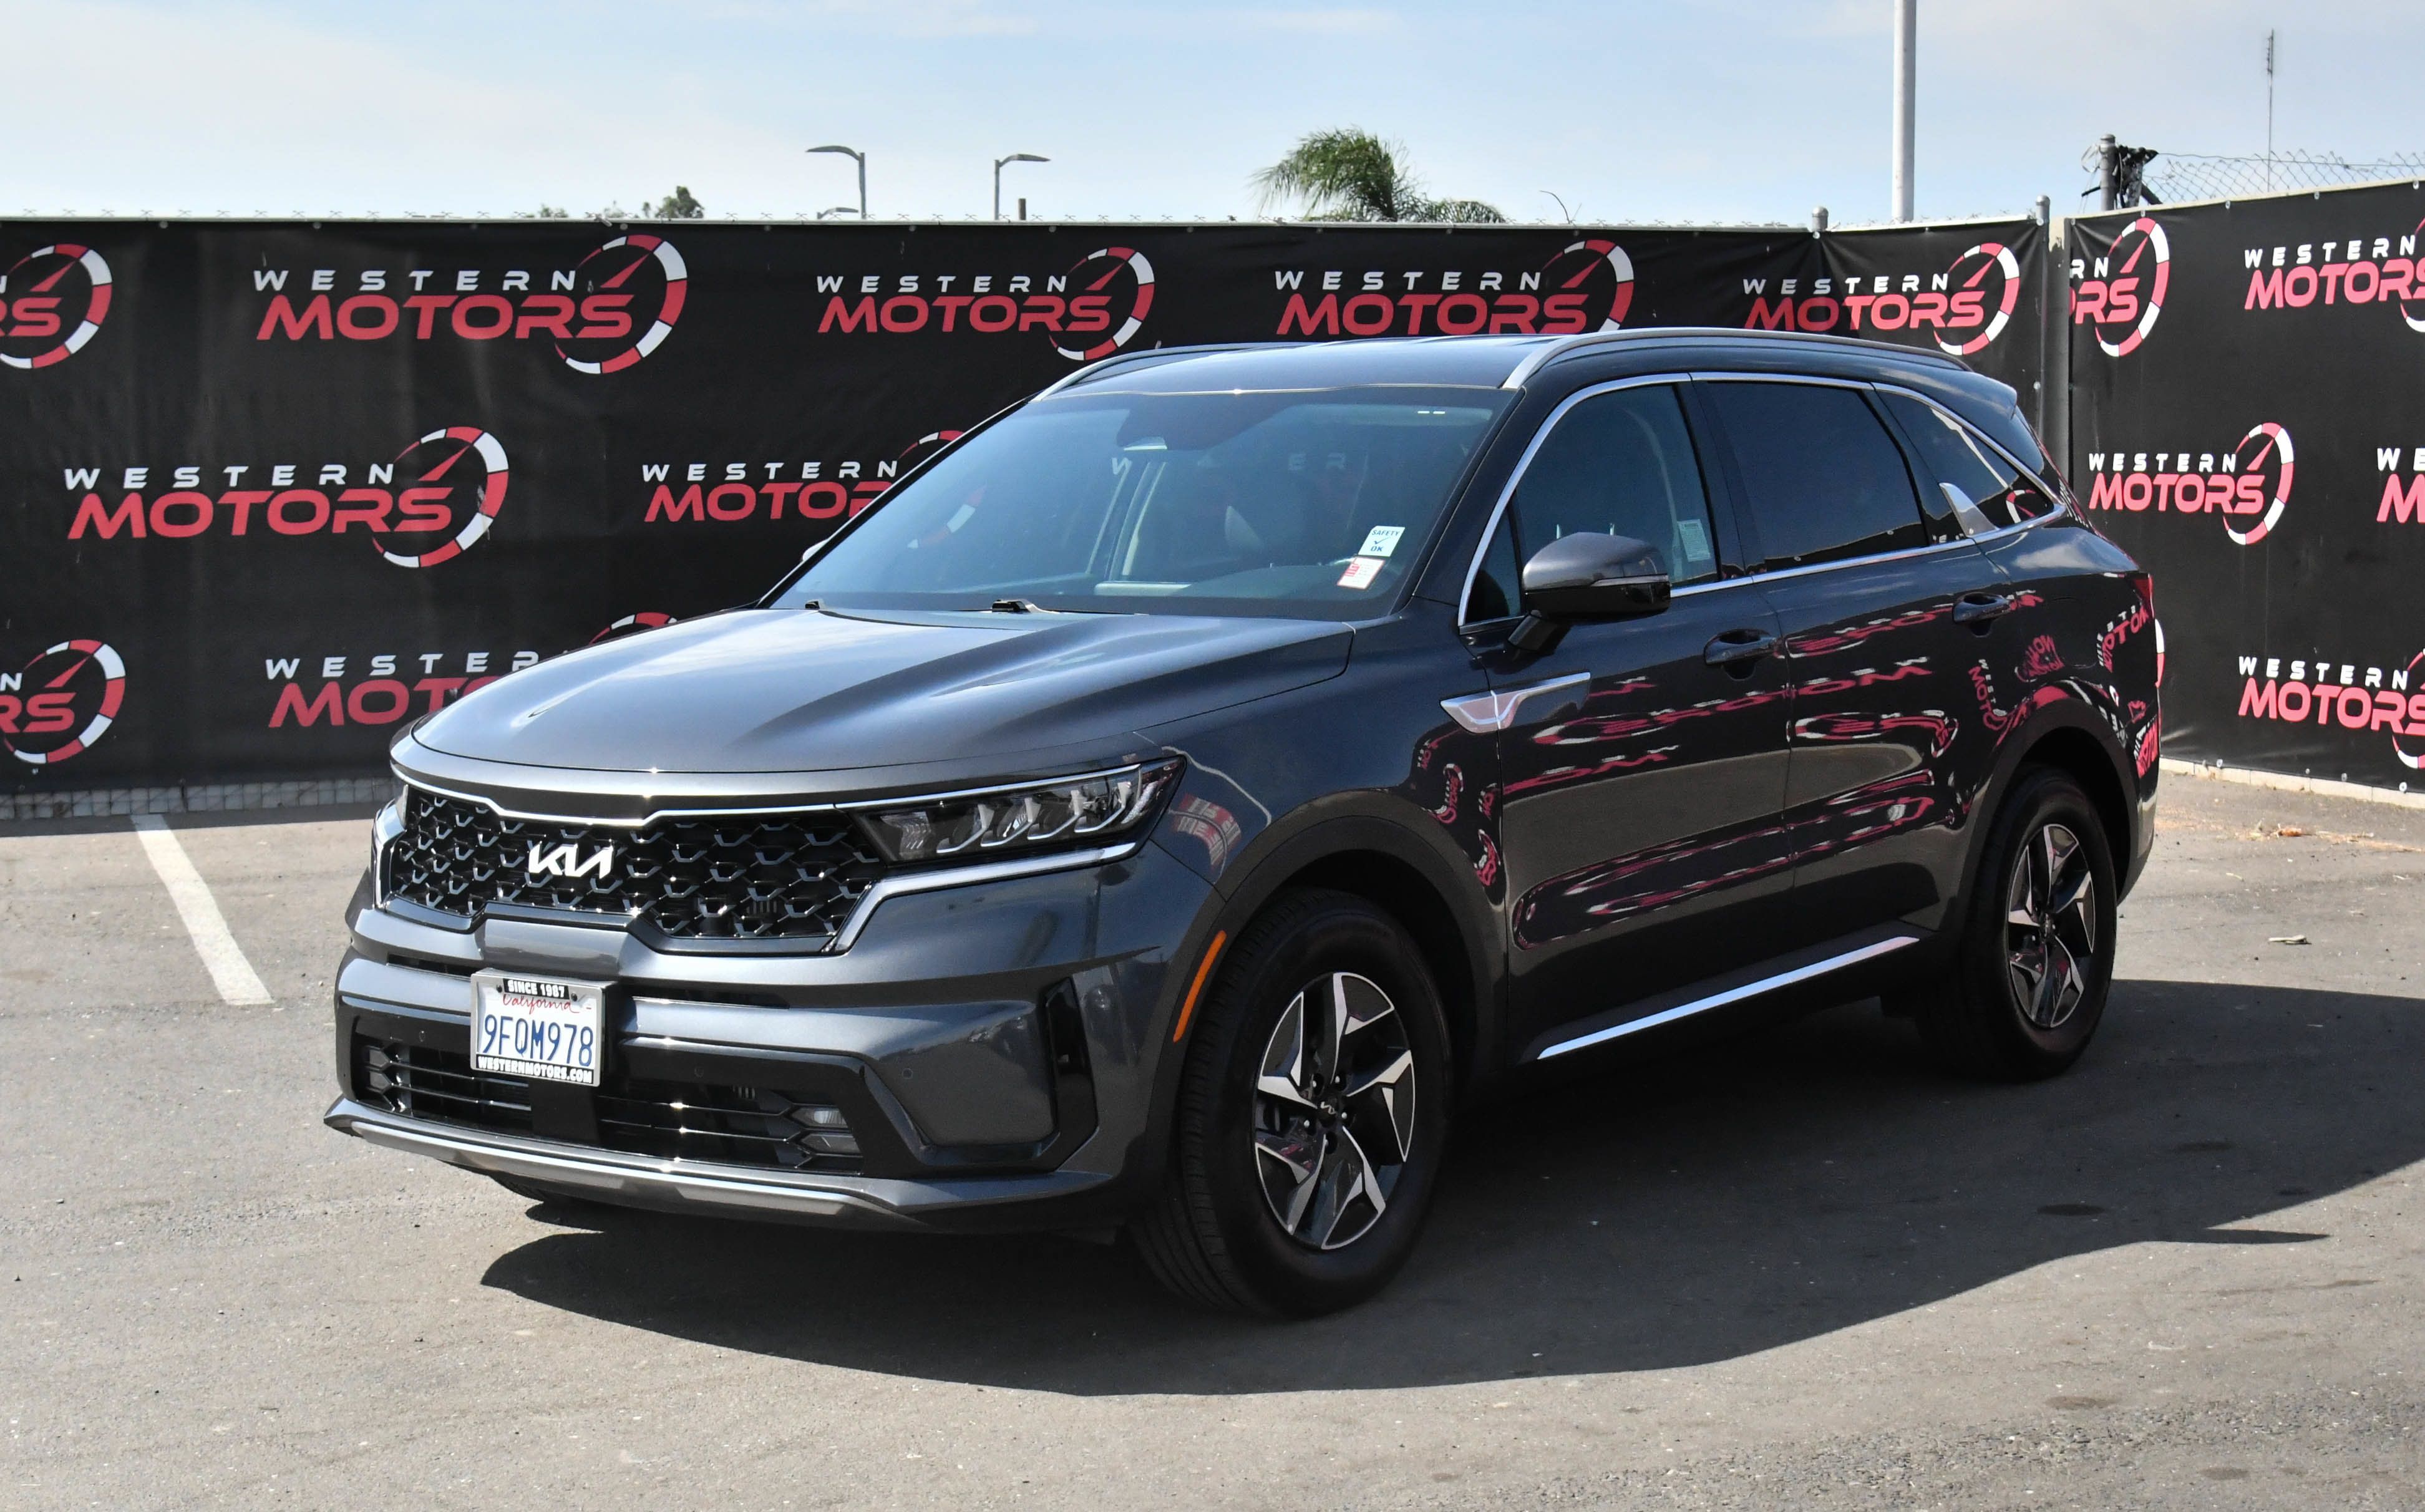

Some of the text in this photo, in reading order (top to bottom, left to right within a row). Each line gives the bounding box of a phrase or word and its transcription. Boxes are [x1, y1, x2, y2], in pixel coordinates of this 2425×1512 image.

[2244, 234, 2416, 269] WESTERN
[253, 269, 576, 291] WESTERN
[817, 276, 1066, 293] WESTERN
[1275, 271, 1541, 291] WESTERN
[1742, 273, 1948, 295] WESTERN
[2244, 257, 2425, 311] MOTOR
[256, 294, 634, 341] MOTORS
[817, 295, 1112, 333] MOTORS
[1276, 293, 1589, 336] MOTORS
[1744, 290, 1986, 331] MOTORS
[2069, 276, 2140, 325] RS
[64, 463, 394, 490] WESTERN
[642, 460, 897, 482] WESTERN
[2088, 452, 2237, 473] WESTERN
[644, 481, 892, 523] MOTOR
[2088, 472, 2266, 515] MOTORS
[67, 487, 454, 540] MOTORS
[265, 650, 568, 680] WESTER
[2238, 656, 2409, 690] WESTERN
[528, 841, 614, 880] KIA
[507, 979, 565, 998] SINCE 1987
[482, 1014, 593, 1067] 9FQM978
[477, 1056, 593, 1084] WESTERNMOTORS.COM
